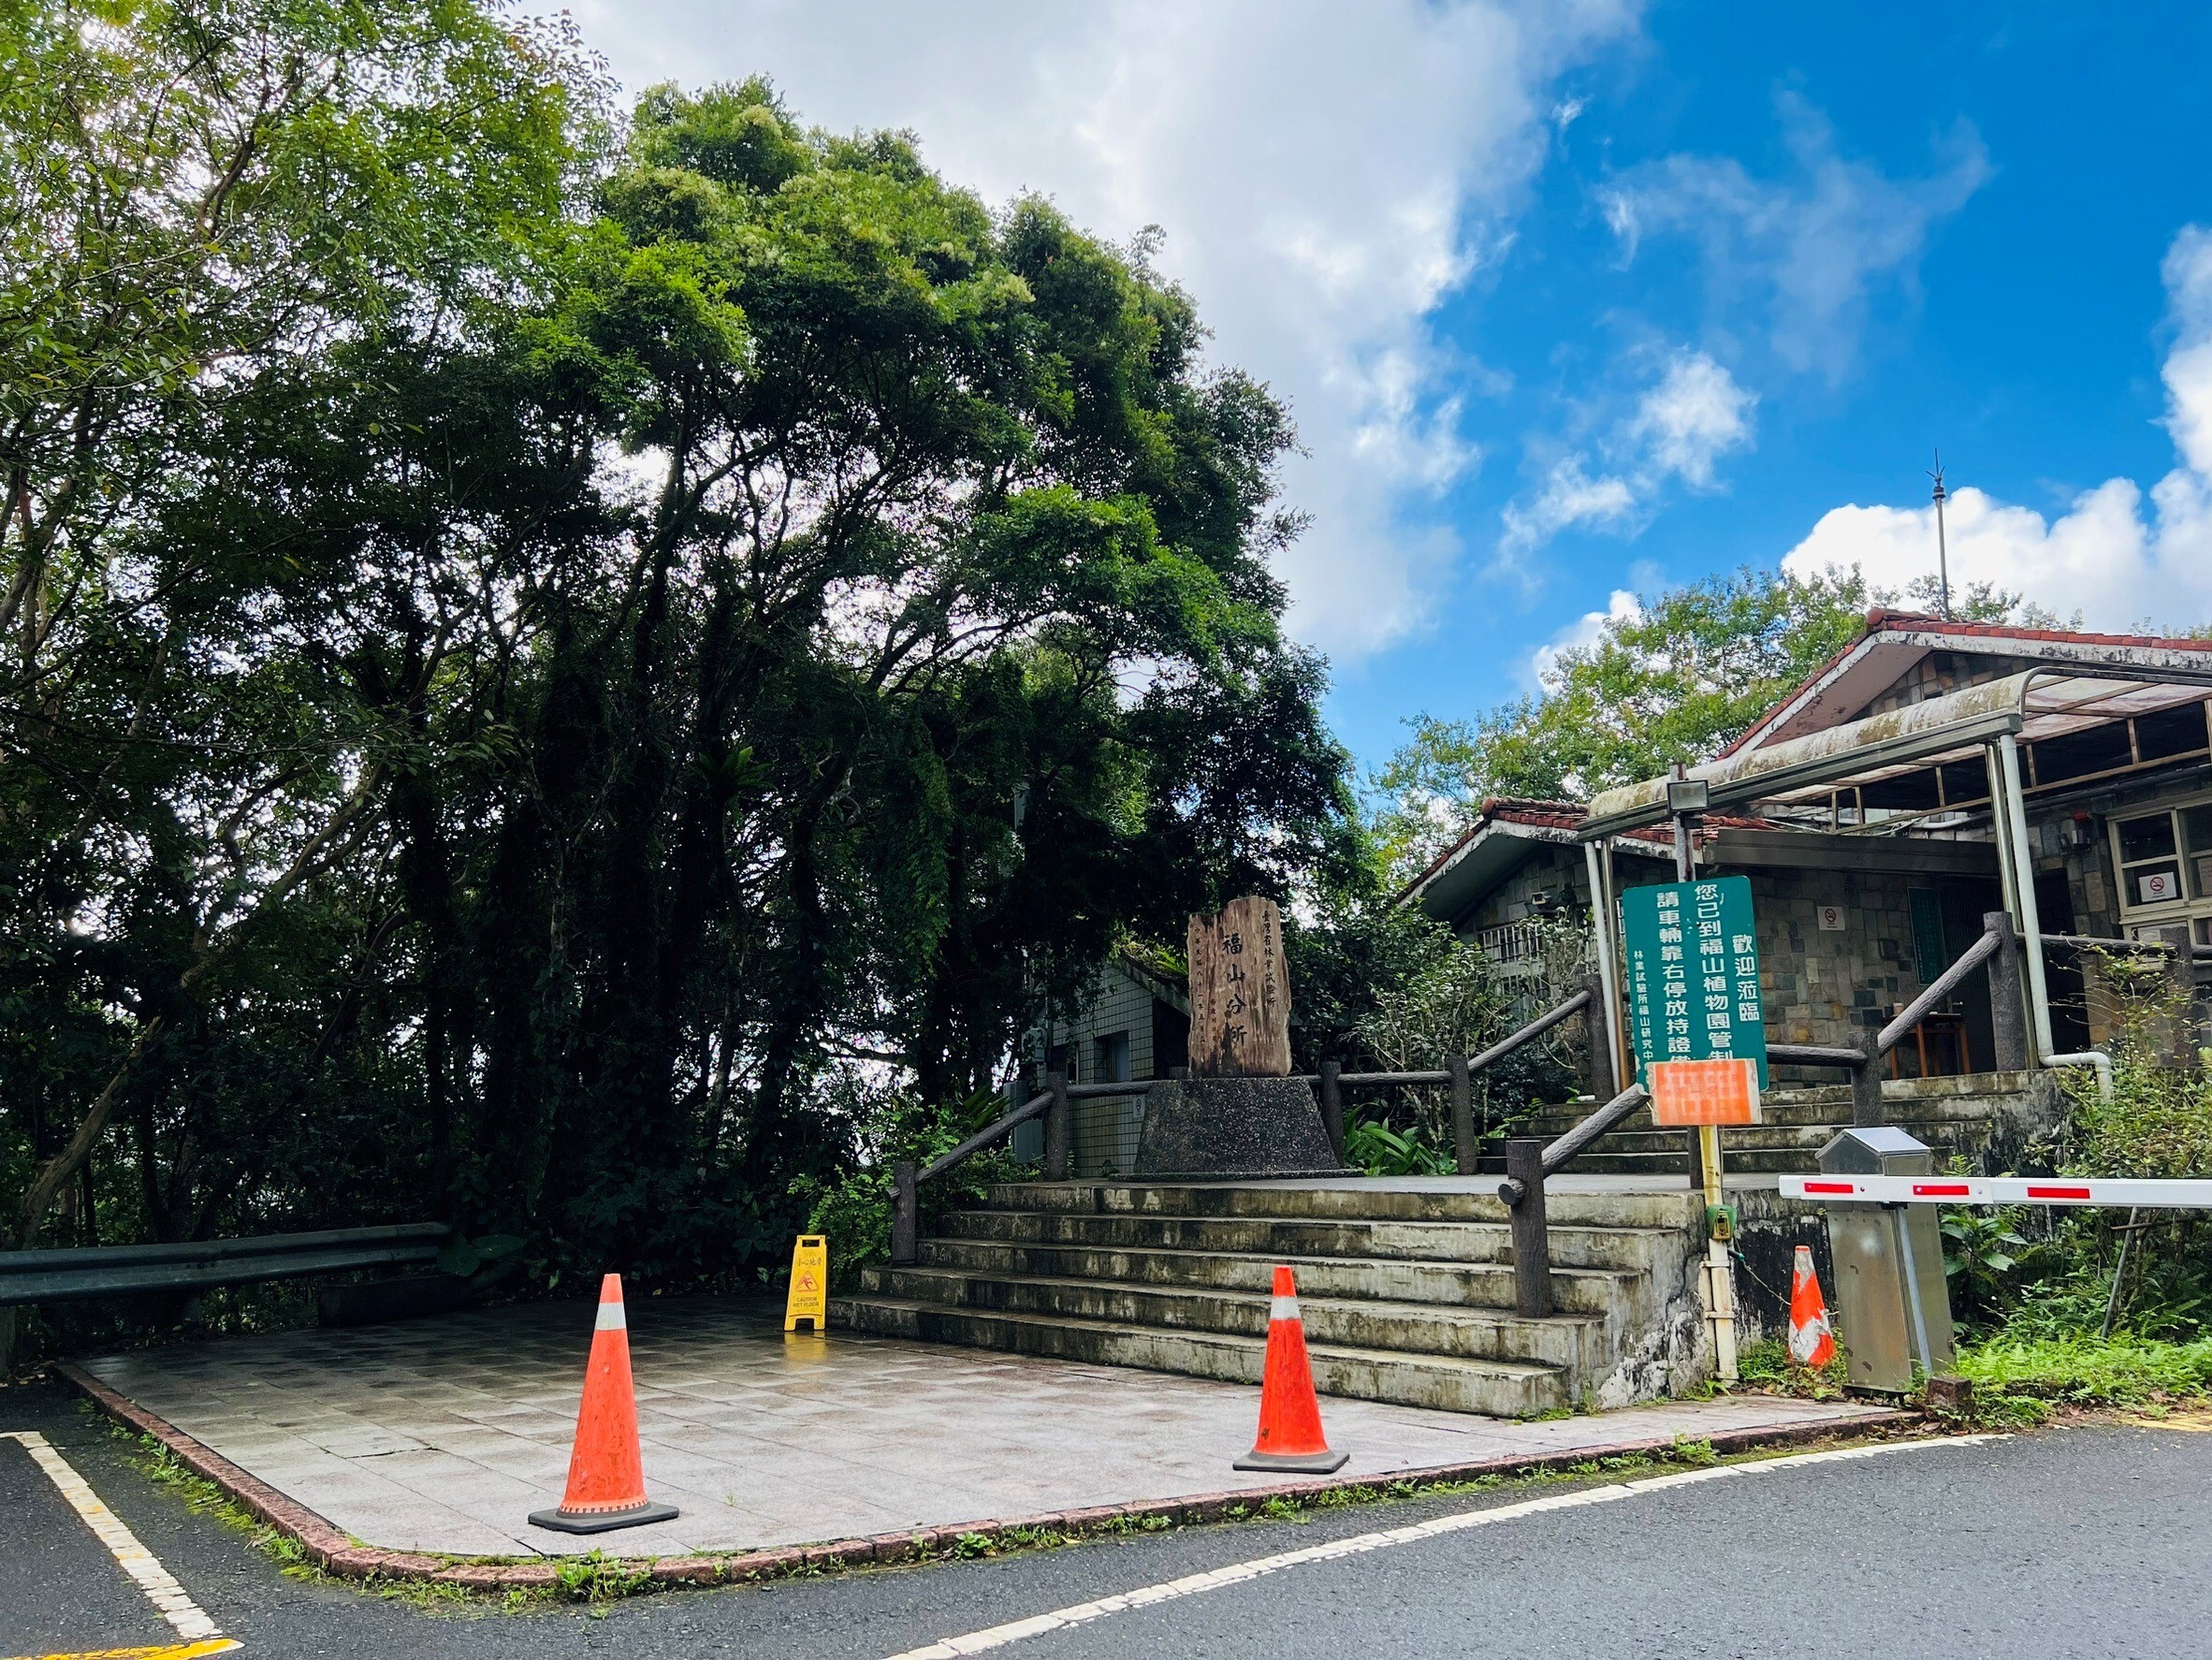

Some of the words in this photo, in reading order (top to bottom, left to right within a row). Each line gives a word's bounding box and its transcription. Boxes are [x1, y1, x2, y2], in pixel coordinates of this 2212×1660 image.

[1222, 932, 1247, 1046] 福山分所
[1634, 950, 1654, 1084] 林業試驗所福山研究中
[1732, 934, 1760, 1022] 歡迎蒞臨
